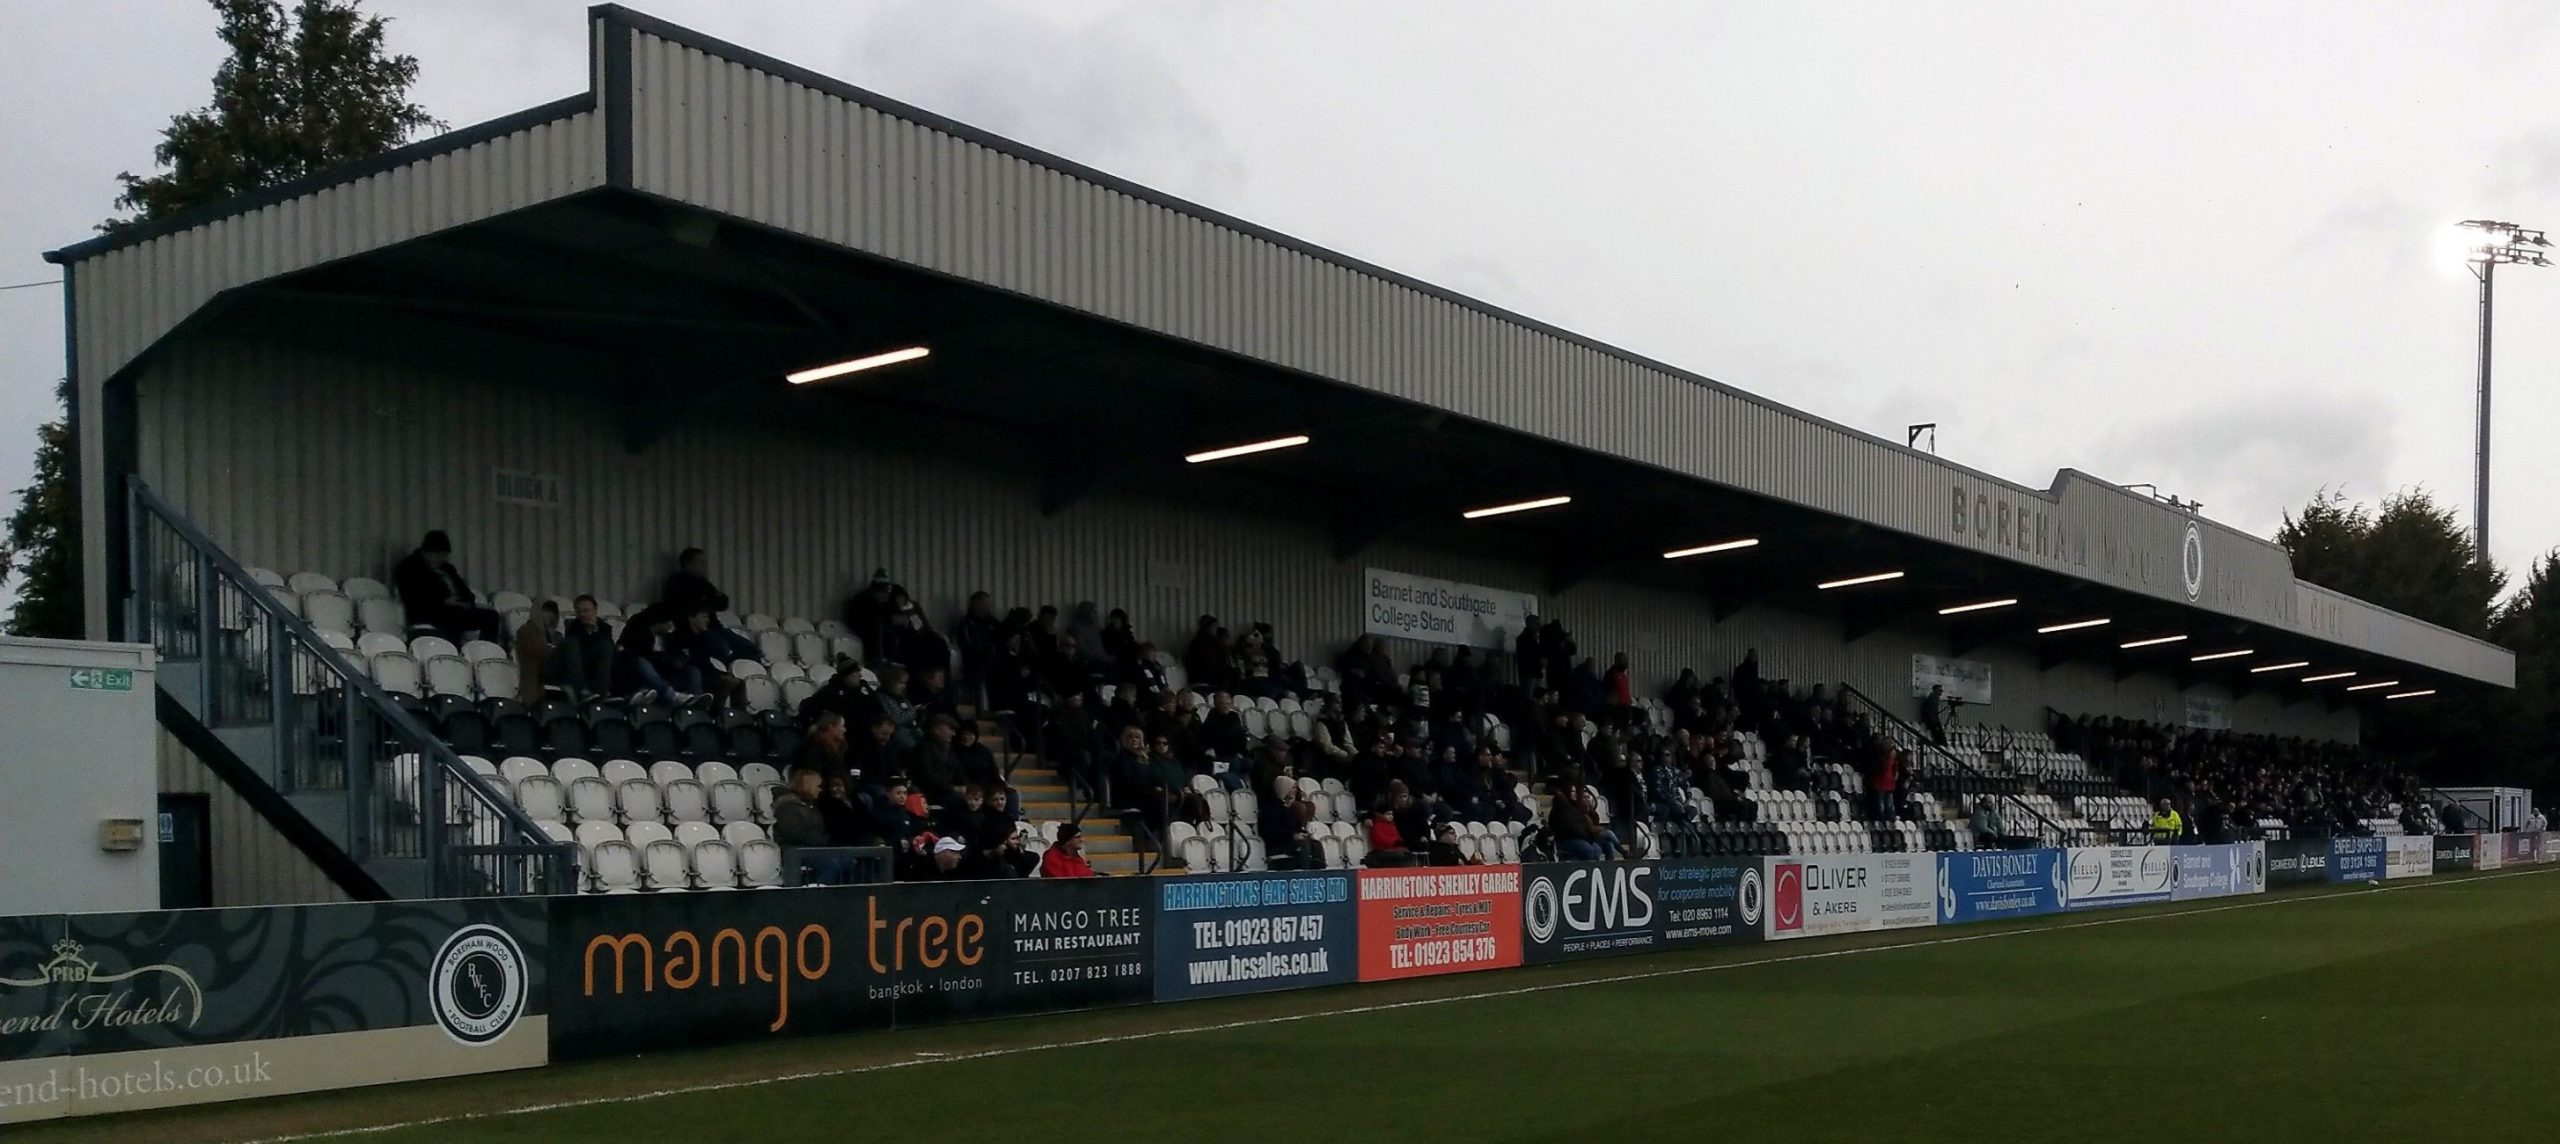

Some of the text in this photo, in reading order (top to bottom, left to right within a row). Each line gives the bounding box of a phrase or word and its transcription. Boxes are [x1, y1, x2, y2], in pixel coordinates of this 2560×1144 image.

[1952, 486, 2086, 567] BOREHAM
[1372, 578, 1497, 617] Barnet and Southgate
[1372, 604, 1455, 634] College Stand
[106, 674, 131, 688] Exit
[2335, 839, 2355, 855] ENFIELD
[2356, 838, 2372, 853] SKIPS
[1658, 866, 1737, 882] Your strategic partner
[1806, 865, 1867, 891] OLIVER
[1972, 854, 2038, 878] DAVIS BONLEY
[2073, 864, 2098, 876] RIELLO
[2144, 862, 2166, 872] RIELLO
[1163, 877, 1348, 911] HARRINGTONS CAR SALES LTD
[1361, 872, 1519, 900] HARRINGTONS SHENLEY GARAGE
[1658, 885, 1736, 902] for corporate mobility
[1393, 905, 1417, 919] Service
[1425, 904, 1451, 918] Repairs
[1455, 902, 1474, 916] Tyres
[1479, 901, 1492, 913] MOT
[1562, 866, 1653, 931] EMS
[1813, 901, 1857, 916] & AKERS
[1014, 908, 1140, 933] MANGO TREE
[1669, 907, 1729, 922] Tel: 020 8963 1114
[1014, 932, 1141, 953] THAI RESTAURANT
[1193, 915, 1323, 949] TEL: 01923 857 457
[1396, 926, 1413, 940] Body
[1414, 925, 1431, 938] Work
[1436, 924, 1450, 936] Free
[1450, 923, 1479, 936] Courtesy
[1479, 921, 1490, 933] Car
[1665, 924, 1732, 940] www.ems-move.com
[448, 939, 509, 966] BOREHAM WOOD
[1390, 937, 1496, 969] TEL: 01923 854 376
[1563, 936, 1653, 952] PEOPLE PLACES PERFORMANCE
[52, 967, 87, 983] PRB
[584, 895, 985, 1032] mango tree
[1014, 963, 1142, 985] TEL. 0207 823 1888
[1189, 947, 1328, 985] www.hcsales.co.uk
[869, 976, 983, 1000] bangkok london
[72, 986, 183, 1032] Hotels
[450, 1009, 508, 1034] FOOTBALL CLUB
